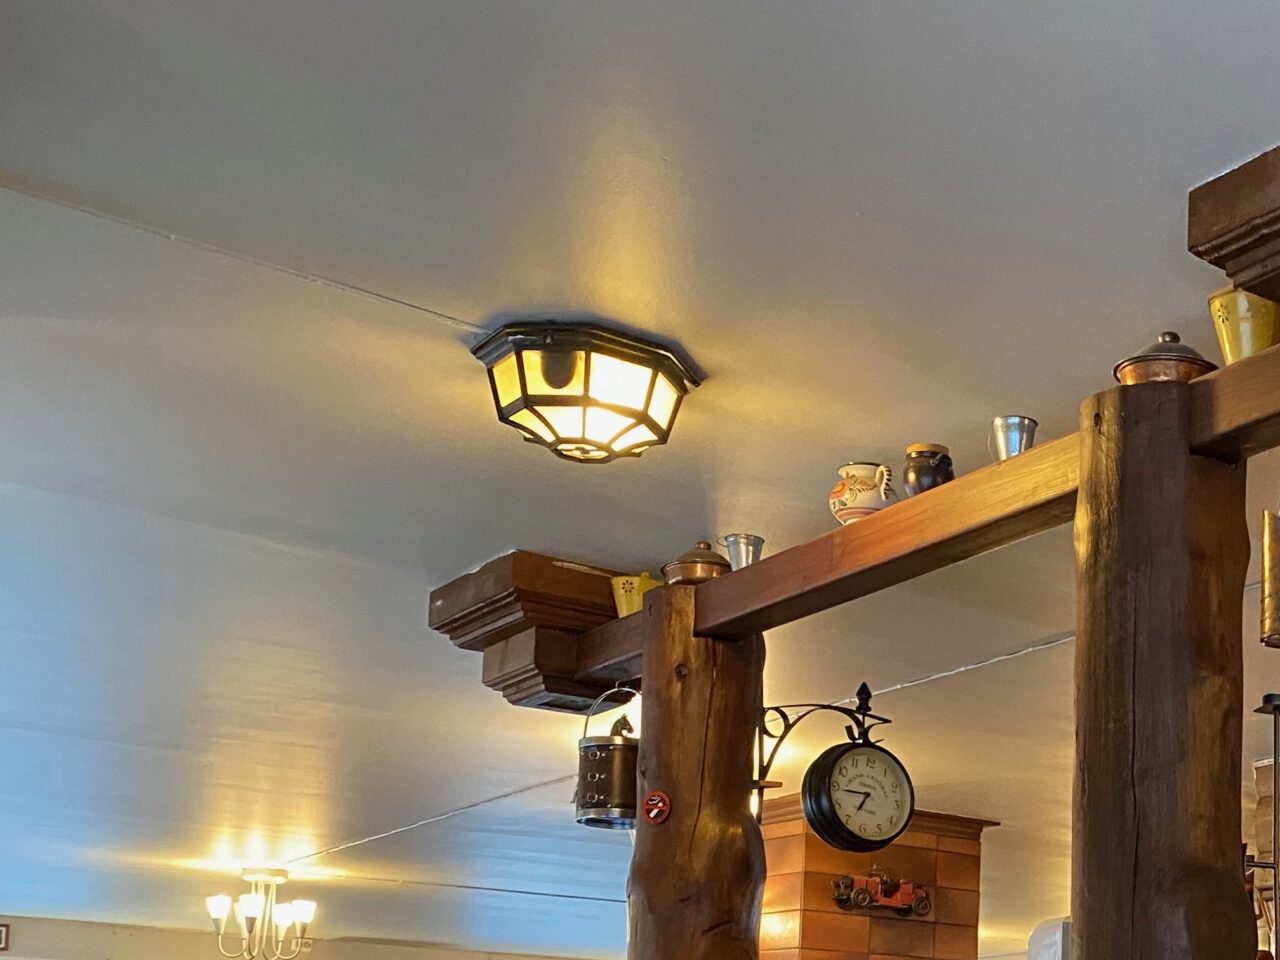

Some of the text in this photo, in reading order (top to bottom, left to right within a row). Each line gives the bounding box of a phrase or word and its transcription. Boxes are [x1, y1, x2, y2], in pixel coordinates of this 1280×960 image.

[851, 757, 858, 768] 11
[866, 757, 876, 769] 12
[838, 767, 847, 777] 10
[832, 780, 840, 791] 9
[892, 784, 898, 793] 2
[836, 800, 841, 810] 8
[894, 800, 900, 810] 3
[845, 815, 852, 825] 7
[859, 824, 866, 833] 6
[877, 824, 883, 833] 5
